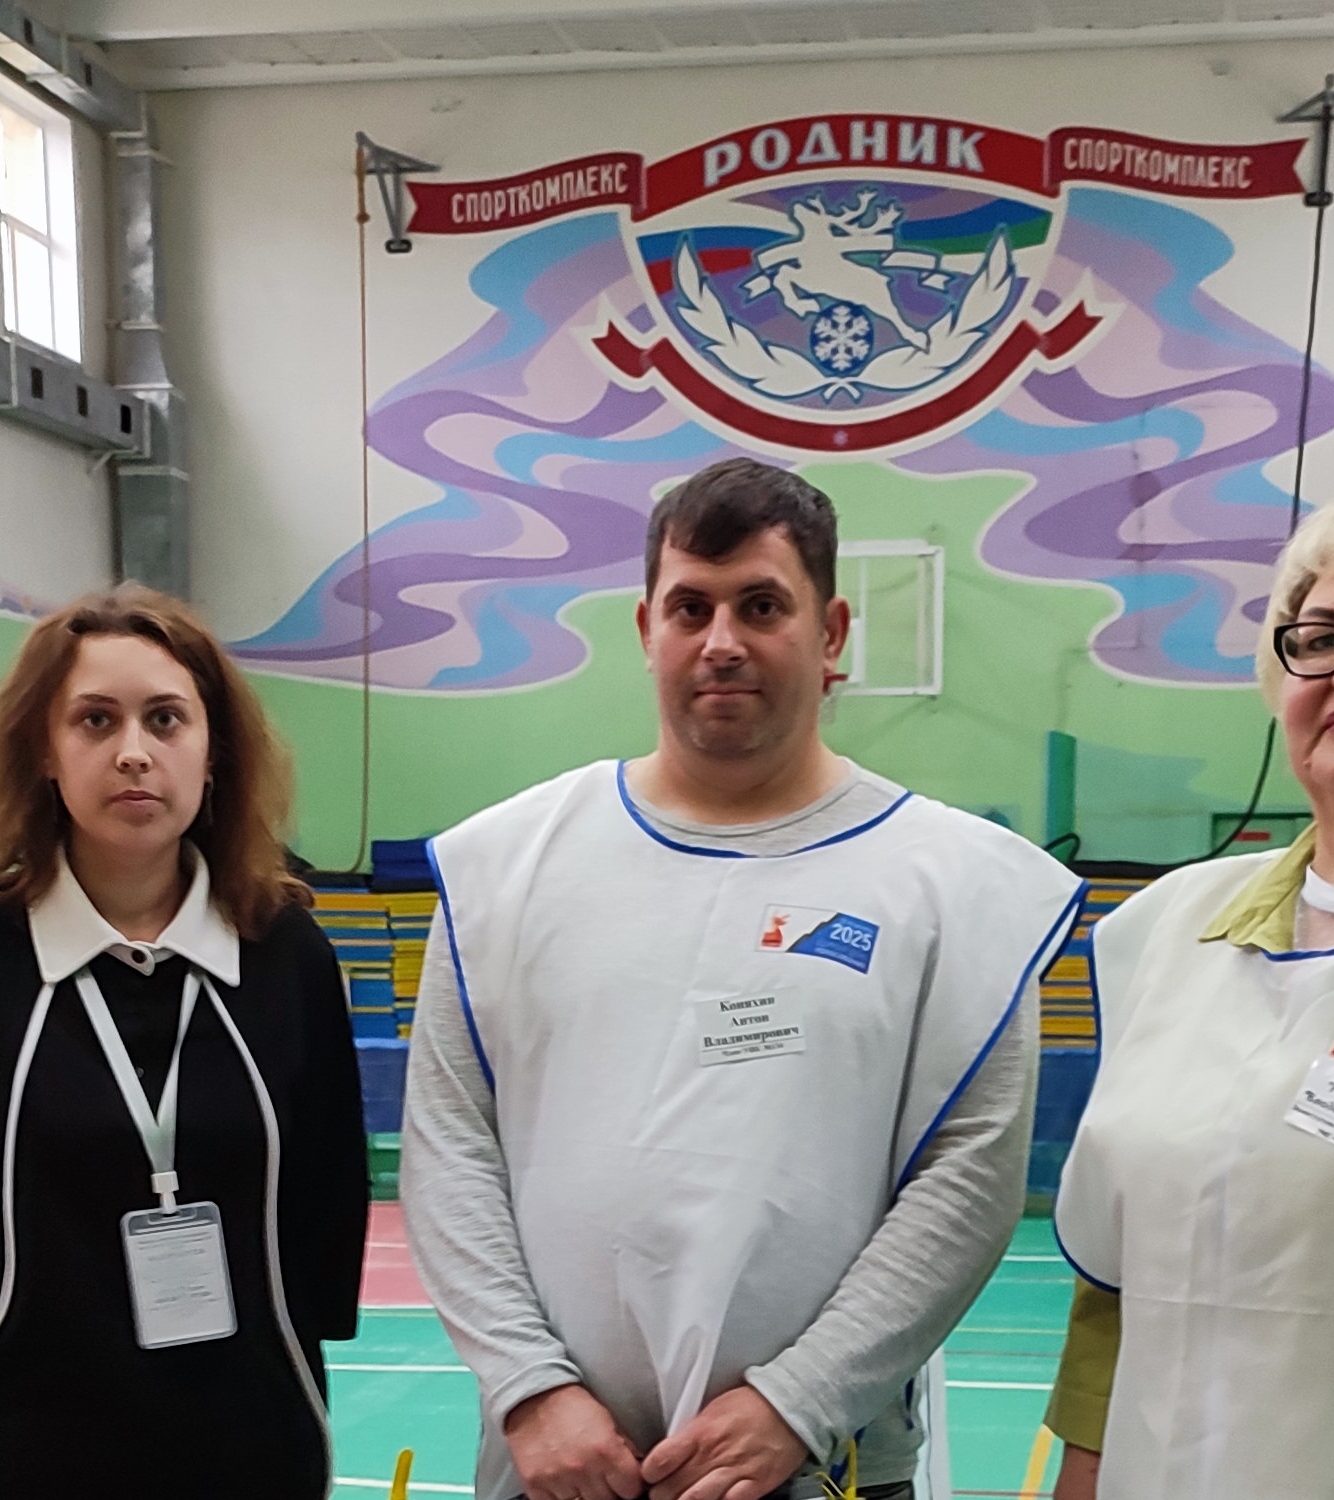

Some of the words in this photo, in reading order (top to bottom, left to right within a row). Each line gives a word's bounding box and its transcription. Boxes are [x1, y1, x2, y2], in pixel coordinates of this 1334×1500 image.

[703, 120, 986, 188] РОДНИК
[1064, 138, 1253, 189] СПОРТКОМПЛЕКС
[451, 162, 629, 223] СПОРТКОМПЛЕКС
[829, 922, 873, 952] 2025
[703, 1027, 800, 1048] Владимирович
[731, 1014, 770, 1027] Антон
